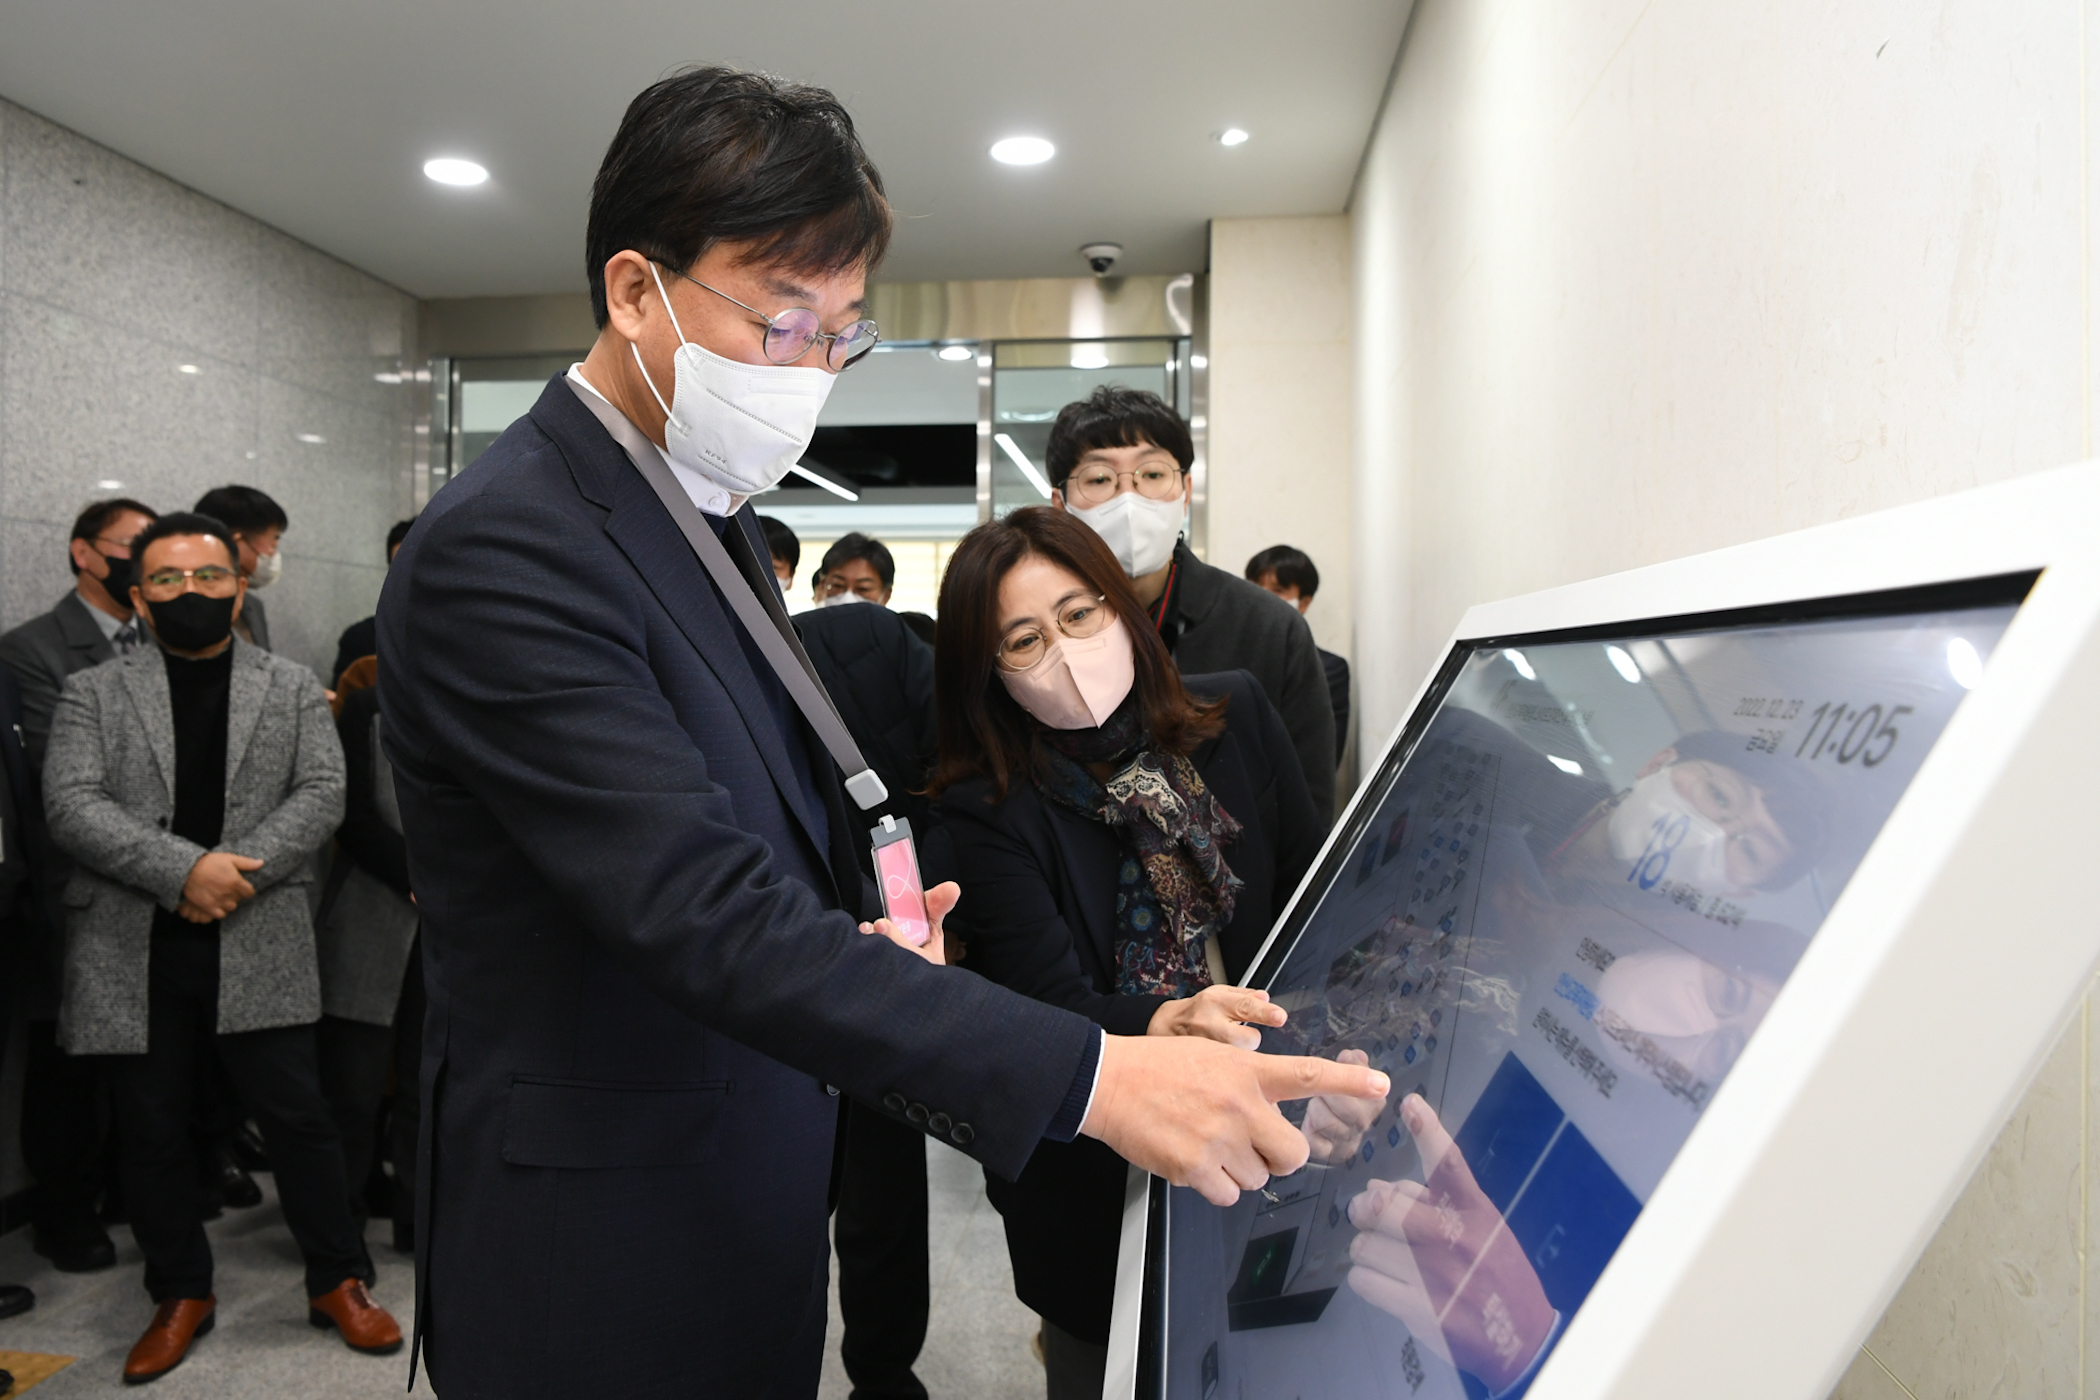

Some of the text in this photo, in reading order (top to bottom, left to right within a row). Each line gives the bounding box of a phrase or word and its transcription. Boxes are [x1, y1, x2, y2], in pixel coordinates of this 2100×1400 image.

[704, 449, 727, 464] KF94
[1794, 701, 1915, 769] 11:05
[1626, 811, 1692, 891] 18
